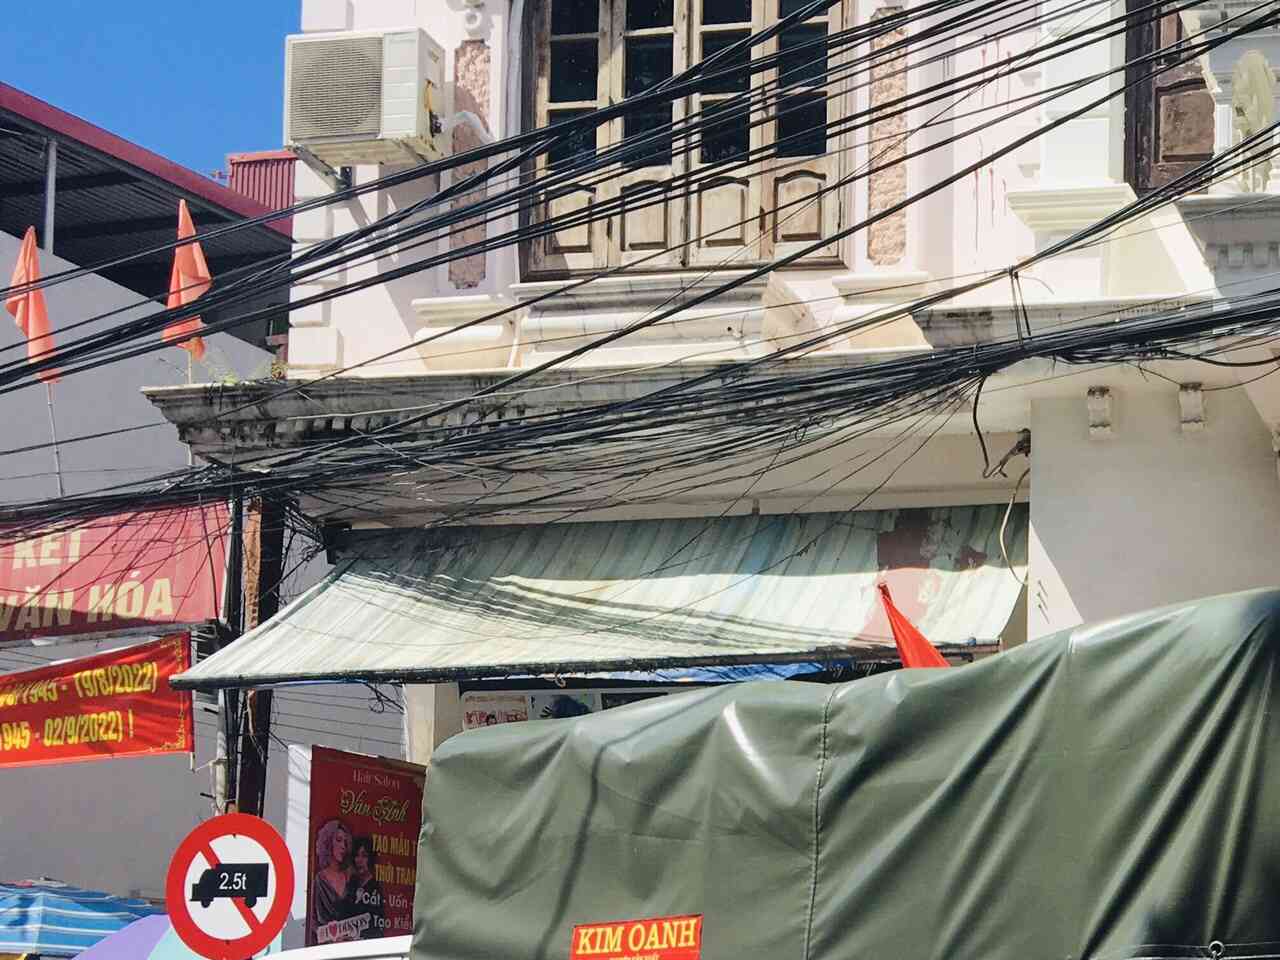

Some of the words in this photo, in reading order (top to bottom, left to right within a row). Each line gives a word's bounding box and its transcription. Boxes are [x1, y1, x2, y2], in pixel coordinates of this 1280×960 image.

[87, 569, 175, 624] HÓA
[219, 873, 247, 891] 2.5t
[575, 926, 625, 955] KIM
[628, 918, 697, 952] OANH
